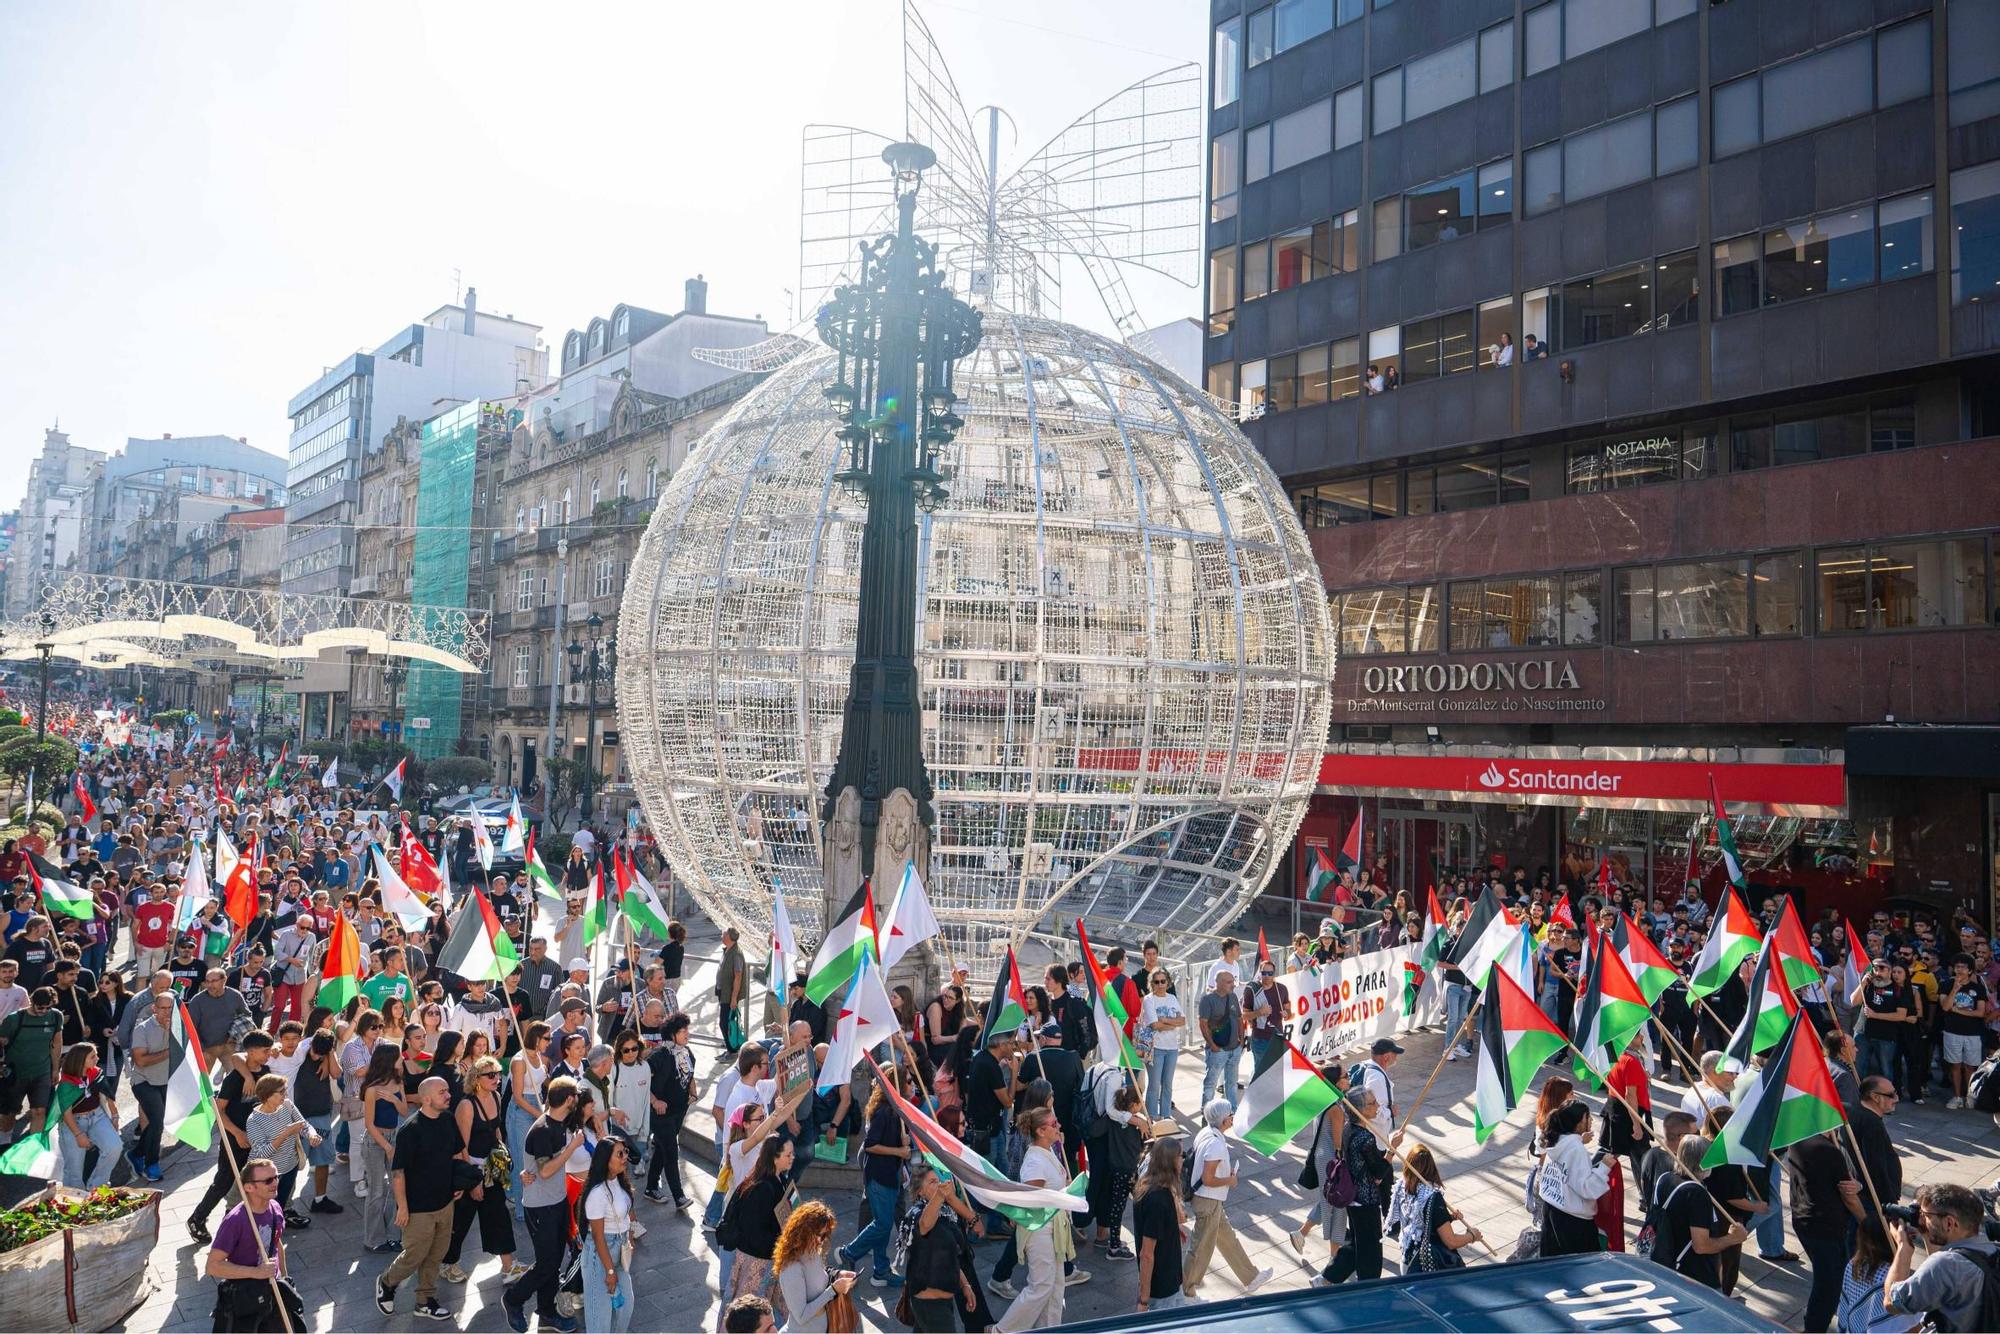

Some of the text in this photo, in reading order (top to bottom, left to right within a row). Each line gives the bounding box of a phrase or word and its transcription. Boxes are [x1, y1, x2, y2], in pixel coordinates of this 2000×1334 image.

[1606, 436, 1671, 457] NOTARIA
[1364, 660, 1580, 693] ORTODONCIA
[1348, 696, 1605, 712] Dra. Montserrat González do Nascimento
[1508, 768, 1622, 791] Santander
[1312, 979, 1351, 1011] TODO
[1356, 970, 1387, 995] PARA
[1301, 1017, 1313, 1036] O
[1320, 996, 1385, 1031] XENOCIDIO
[1311, 1041, 1324, 1056] de
